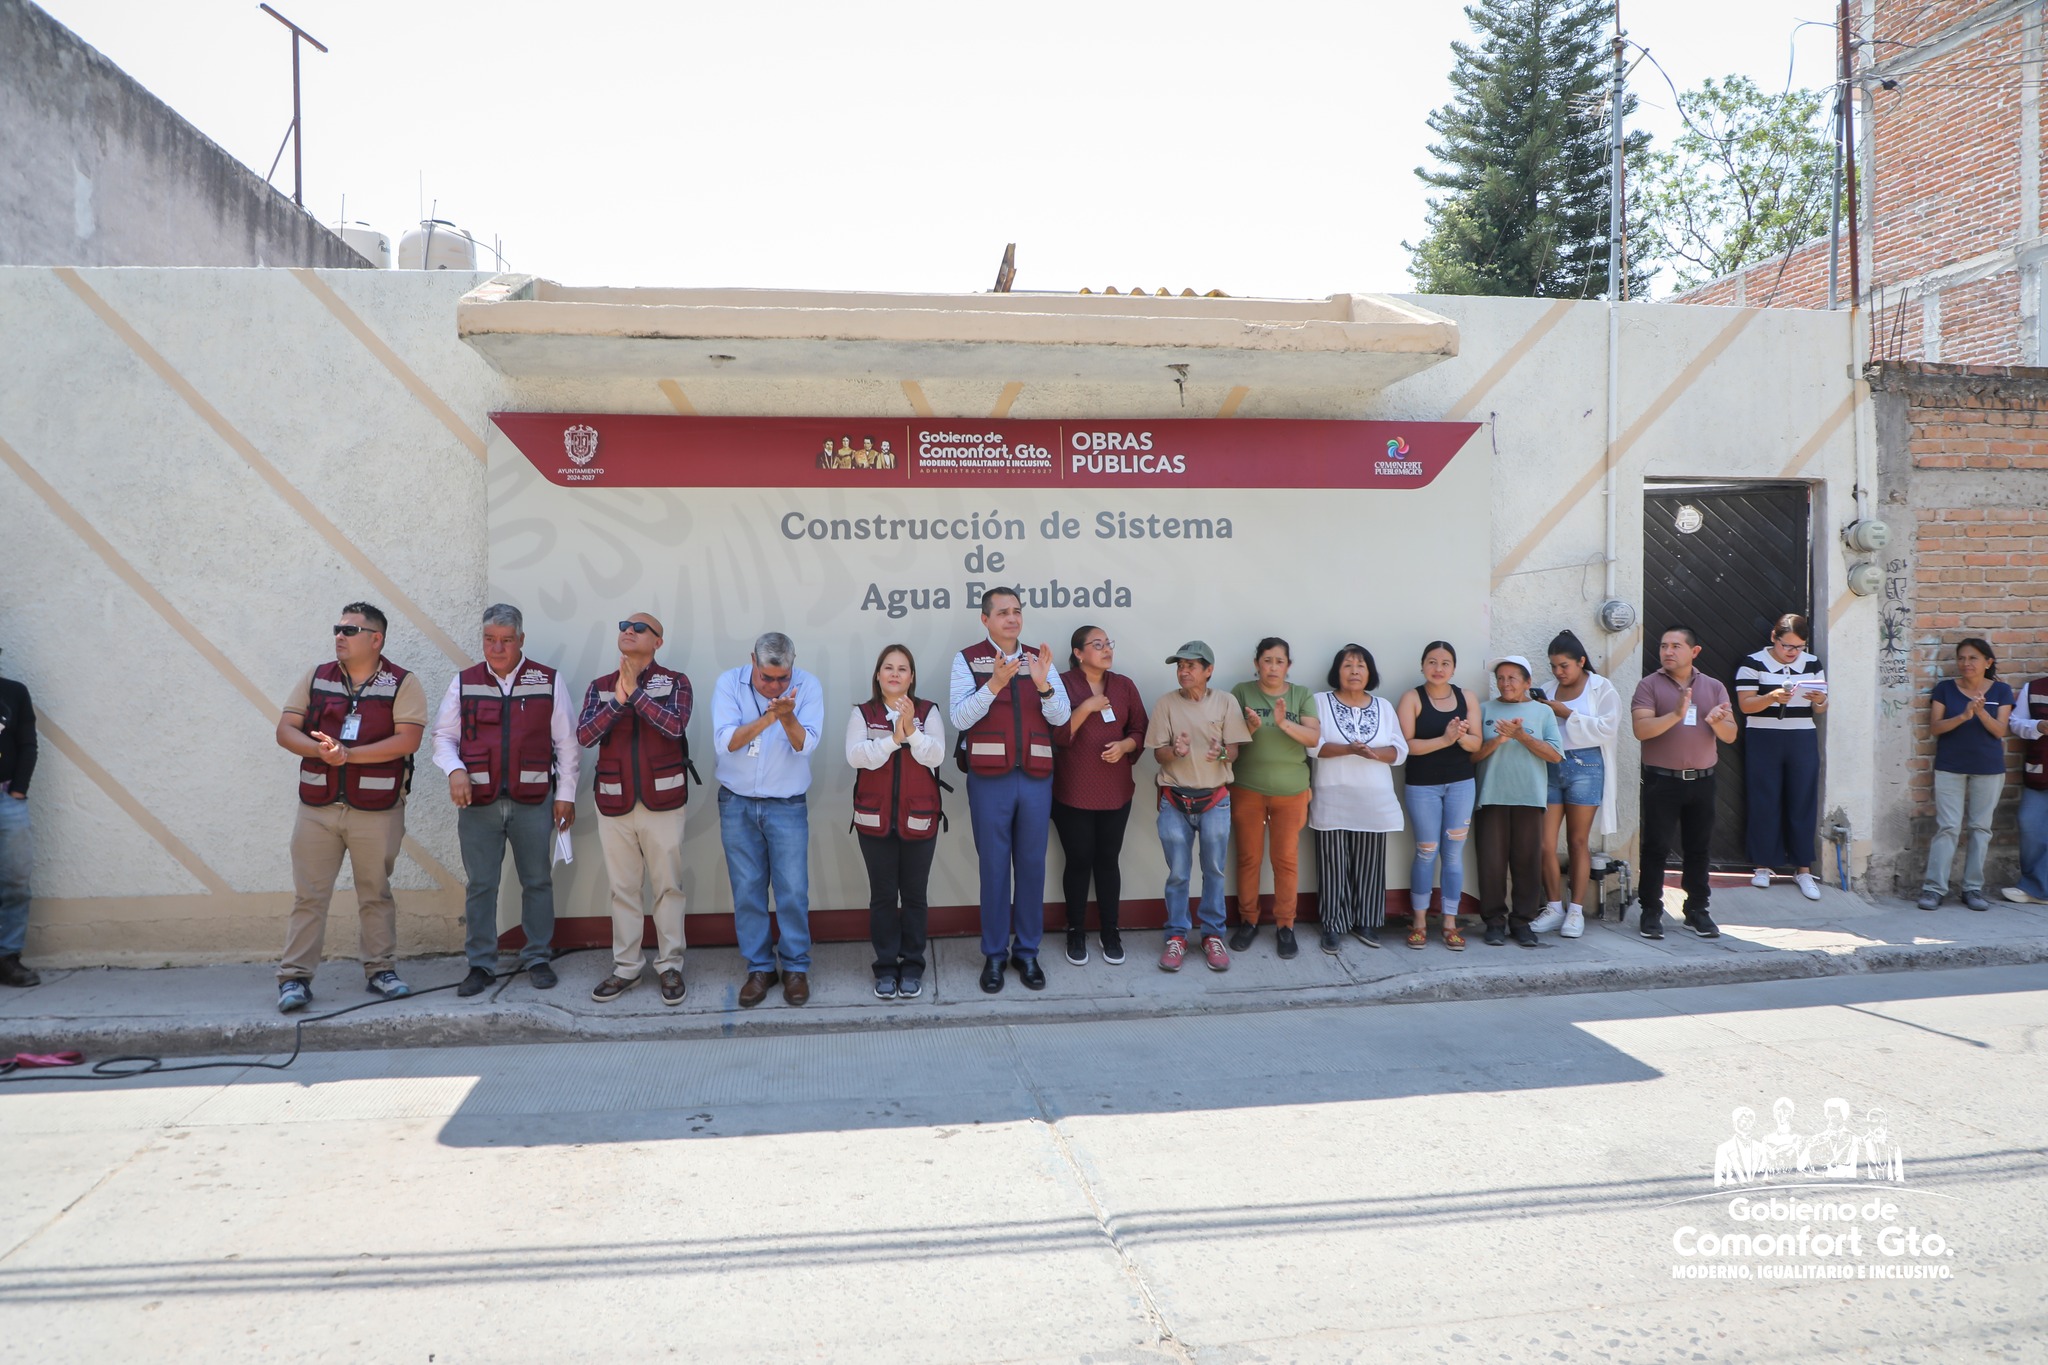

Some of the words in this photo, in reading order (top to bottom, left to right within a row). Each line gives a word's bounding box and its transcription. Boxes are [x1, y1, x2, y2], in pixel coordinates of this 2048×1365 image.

[919, 431, 983, 443] Gobierno
[984, 432, 1003, 443] de
[1071, 432, 1153, 450] OBRAS
[919, 444, 1012, 459] Comonfort,
[1015, 444, 1052, 459] Gto.
[919, 460, 959, 468] MODERNO,
[960, 460, 1005, 468] IGUALITARIO
[1072, 451, 1186, 474] PÚBLICAS
[781, 509, 1026, 540] Construcción
[1040, 510, 1081, 540] de
[1094, 511, 1233, 539] Sistema
[964, 544, 1006, 573] de
[860, 583, 951, 619] Agua
[965, 579, 1133, 609] Etubada
[1252, 708, 1271, 717] EW
